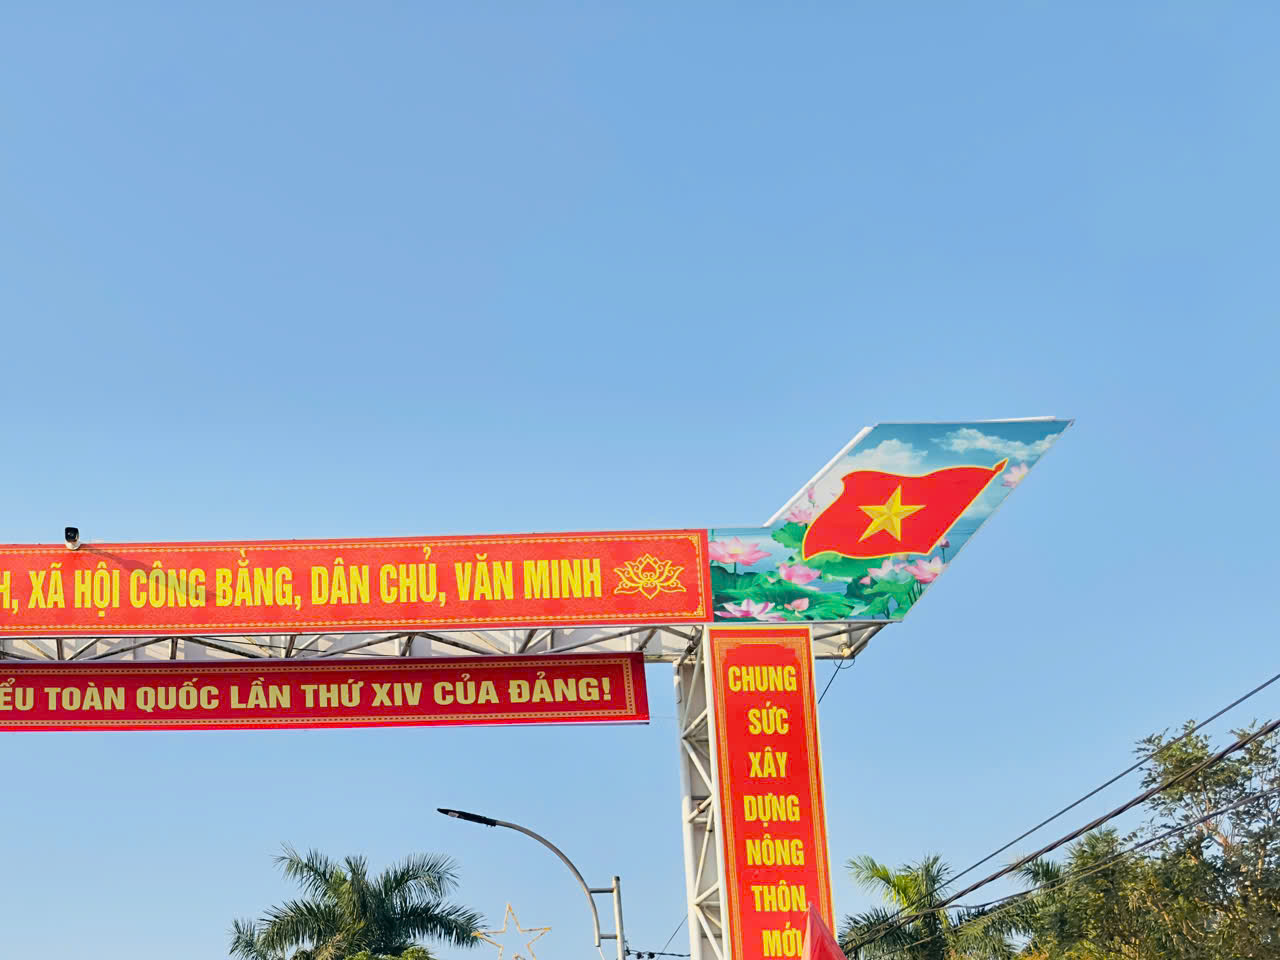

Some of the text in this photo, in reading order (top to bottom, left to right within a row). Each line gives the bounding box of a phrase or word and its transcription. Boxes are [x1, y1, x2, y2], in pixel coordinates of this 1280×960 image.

[28, 562, 66, 609] XÃ
[74, 561, 120, 617] HỘI
[129, 560, 206, 609] CÔNG
[215, 548, 302, 611] BẰNG,
[311, 556, 370, 605] DÂN
[379, 546, 446, 608] CHỦ,
[454, 553, 514, 601] VĂN
[523, 558, 602, 600] MINH
[44, 682, 126, 711] TOÀN
[136, 677, 220, 713] QUỐC
[230, 676, 291, 709] LẦN
[301, 678, 364, 708] THỨ
[371, 682, 423, 706] XIV
[433, 673, 500, 706] CỦA
[508, 671, 612, 704] ĐẢNG!
[728, 665, 797, 693] CHUNG
[748, 702, 789, 735] SỨC
[749, 746, 788, 778] XÂY
[743, 792, 801, 828] DỰNG
[746, 834, 805, 866] NÔNG
[751, 880, 807, 913] THÔN
